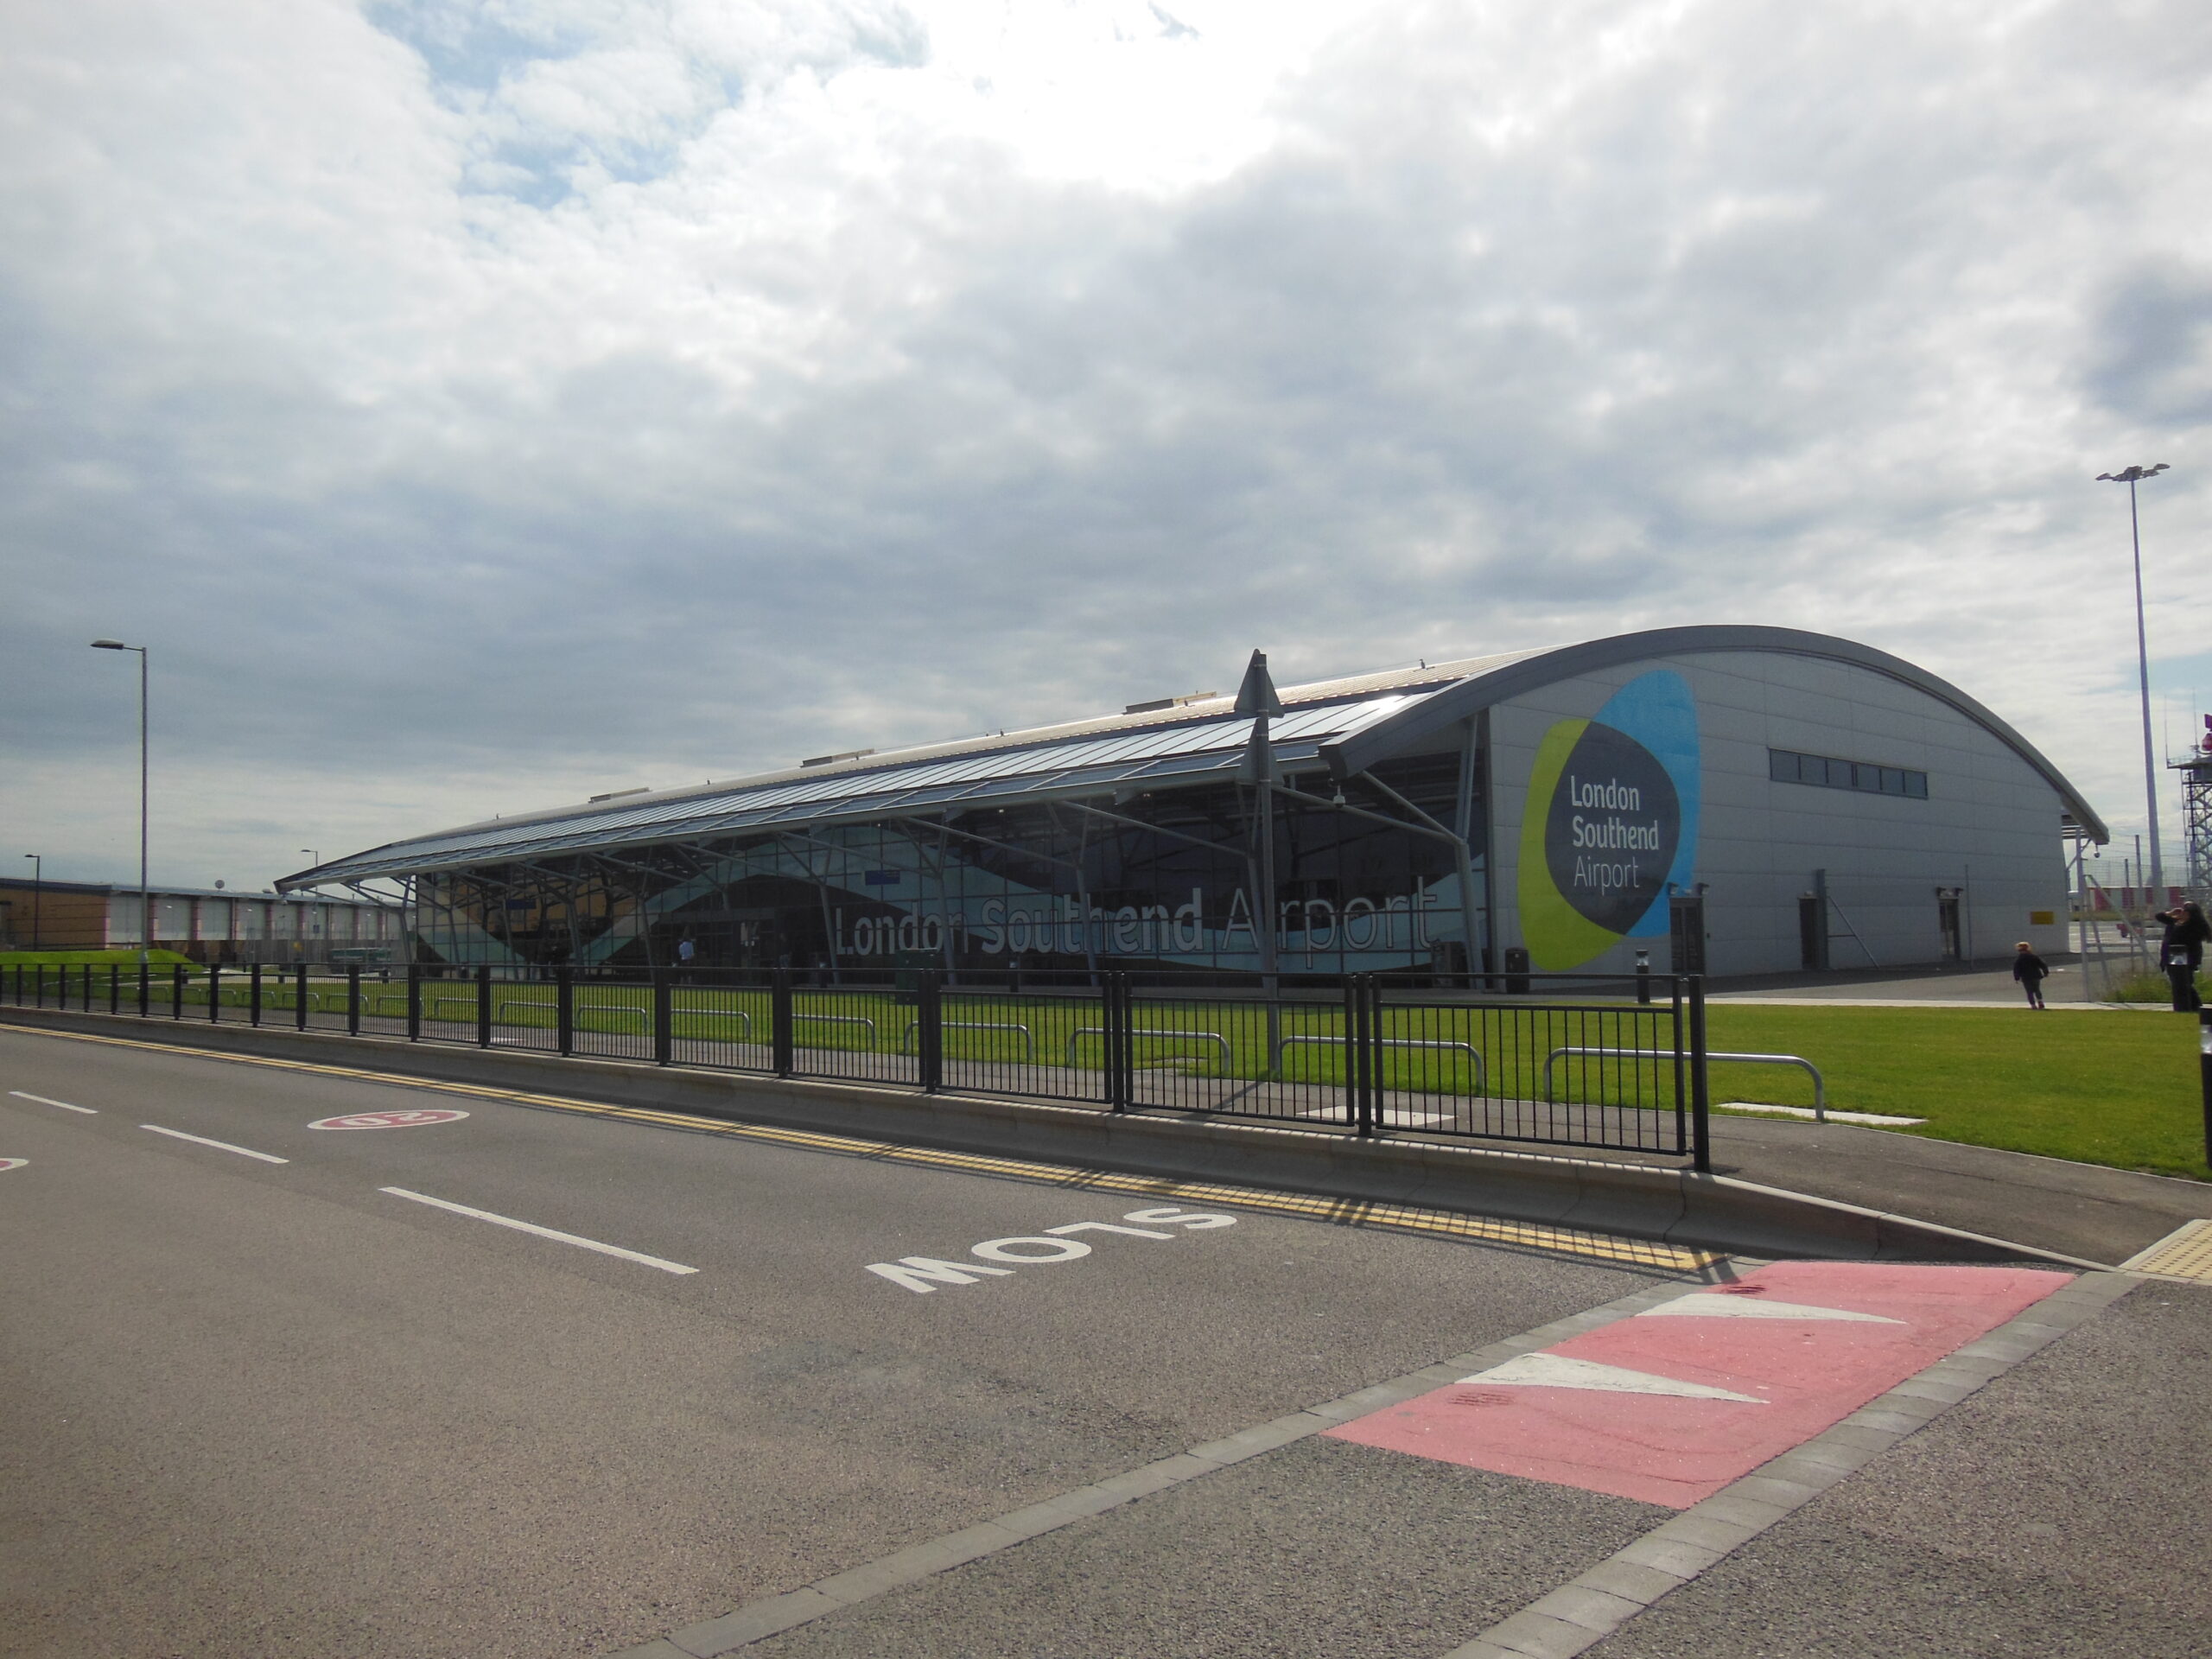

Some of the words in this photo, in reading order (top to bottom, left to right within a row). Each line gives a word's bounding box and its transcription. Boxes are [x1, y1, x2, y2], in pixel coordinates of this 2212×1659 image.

[1571, 775, 1640, 810] London
[1572, 815, 1659, 850] Southend
[1573, 855, 1639, 896] Airport
[835, 902, 969, 956] London
[982, 887, 1203, 954] Southend
[1222, 875, 1438, 969] Arport
[340, 1112, 437, 1127] 20
[864, 1207, 1237, 1294] SLOW
